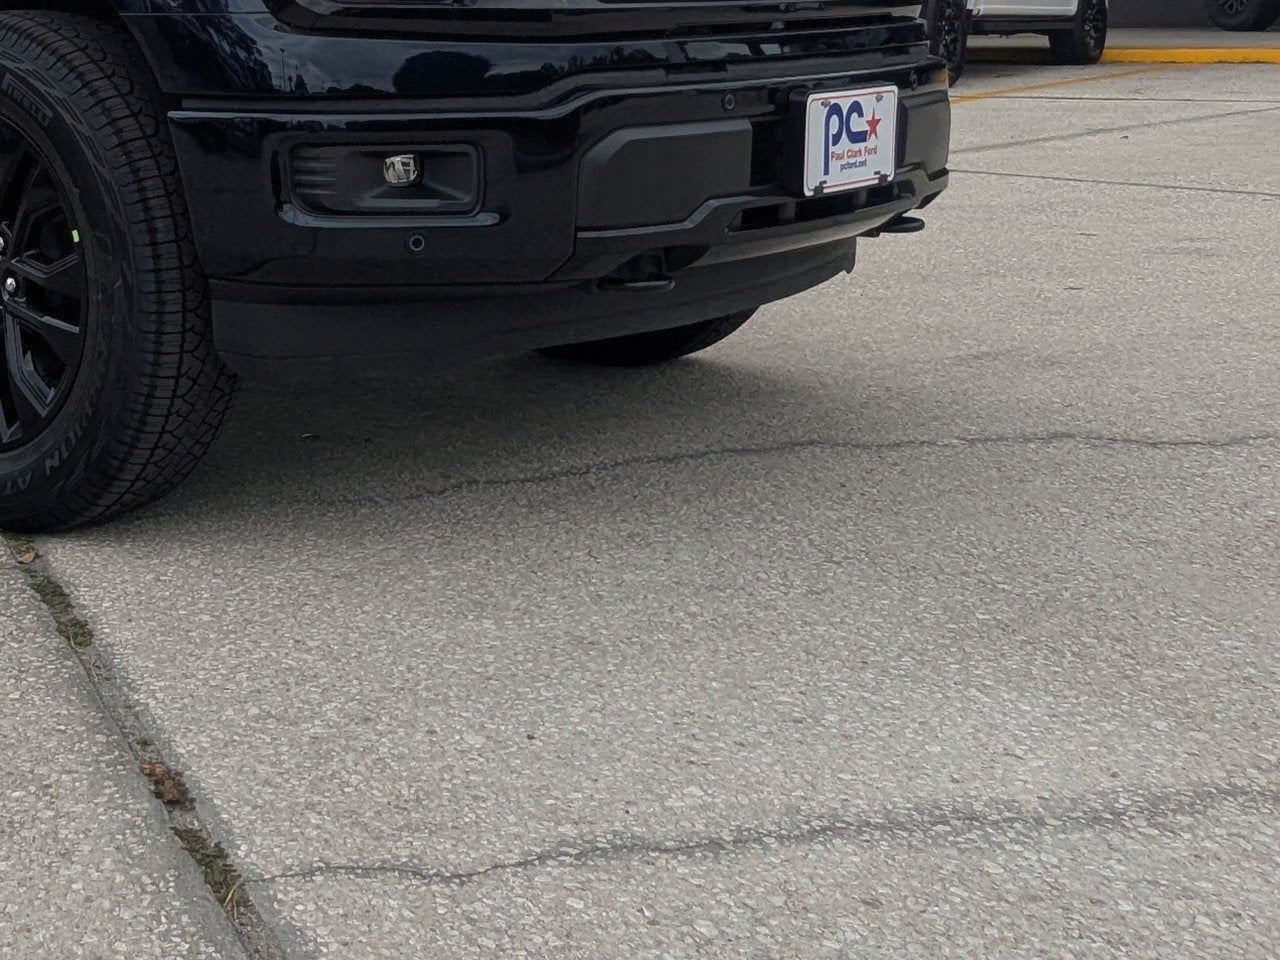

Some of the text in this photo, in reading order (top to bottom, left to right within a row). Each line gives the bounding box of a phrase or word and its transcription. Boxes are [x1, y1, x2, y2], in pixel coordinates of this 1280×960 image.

[831, 145, 878, 162] Paul Clark Ford
